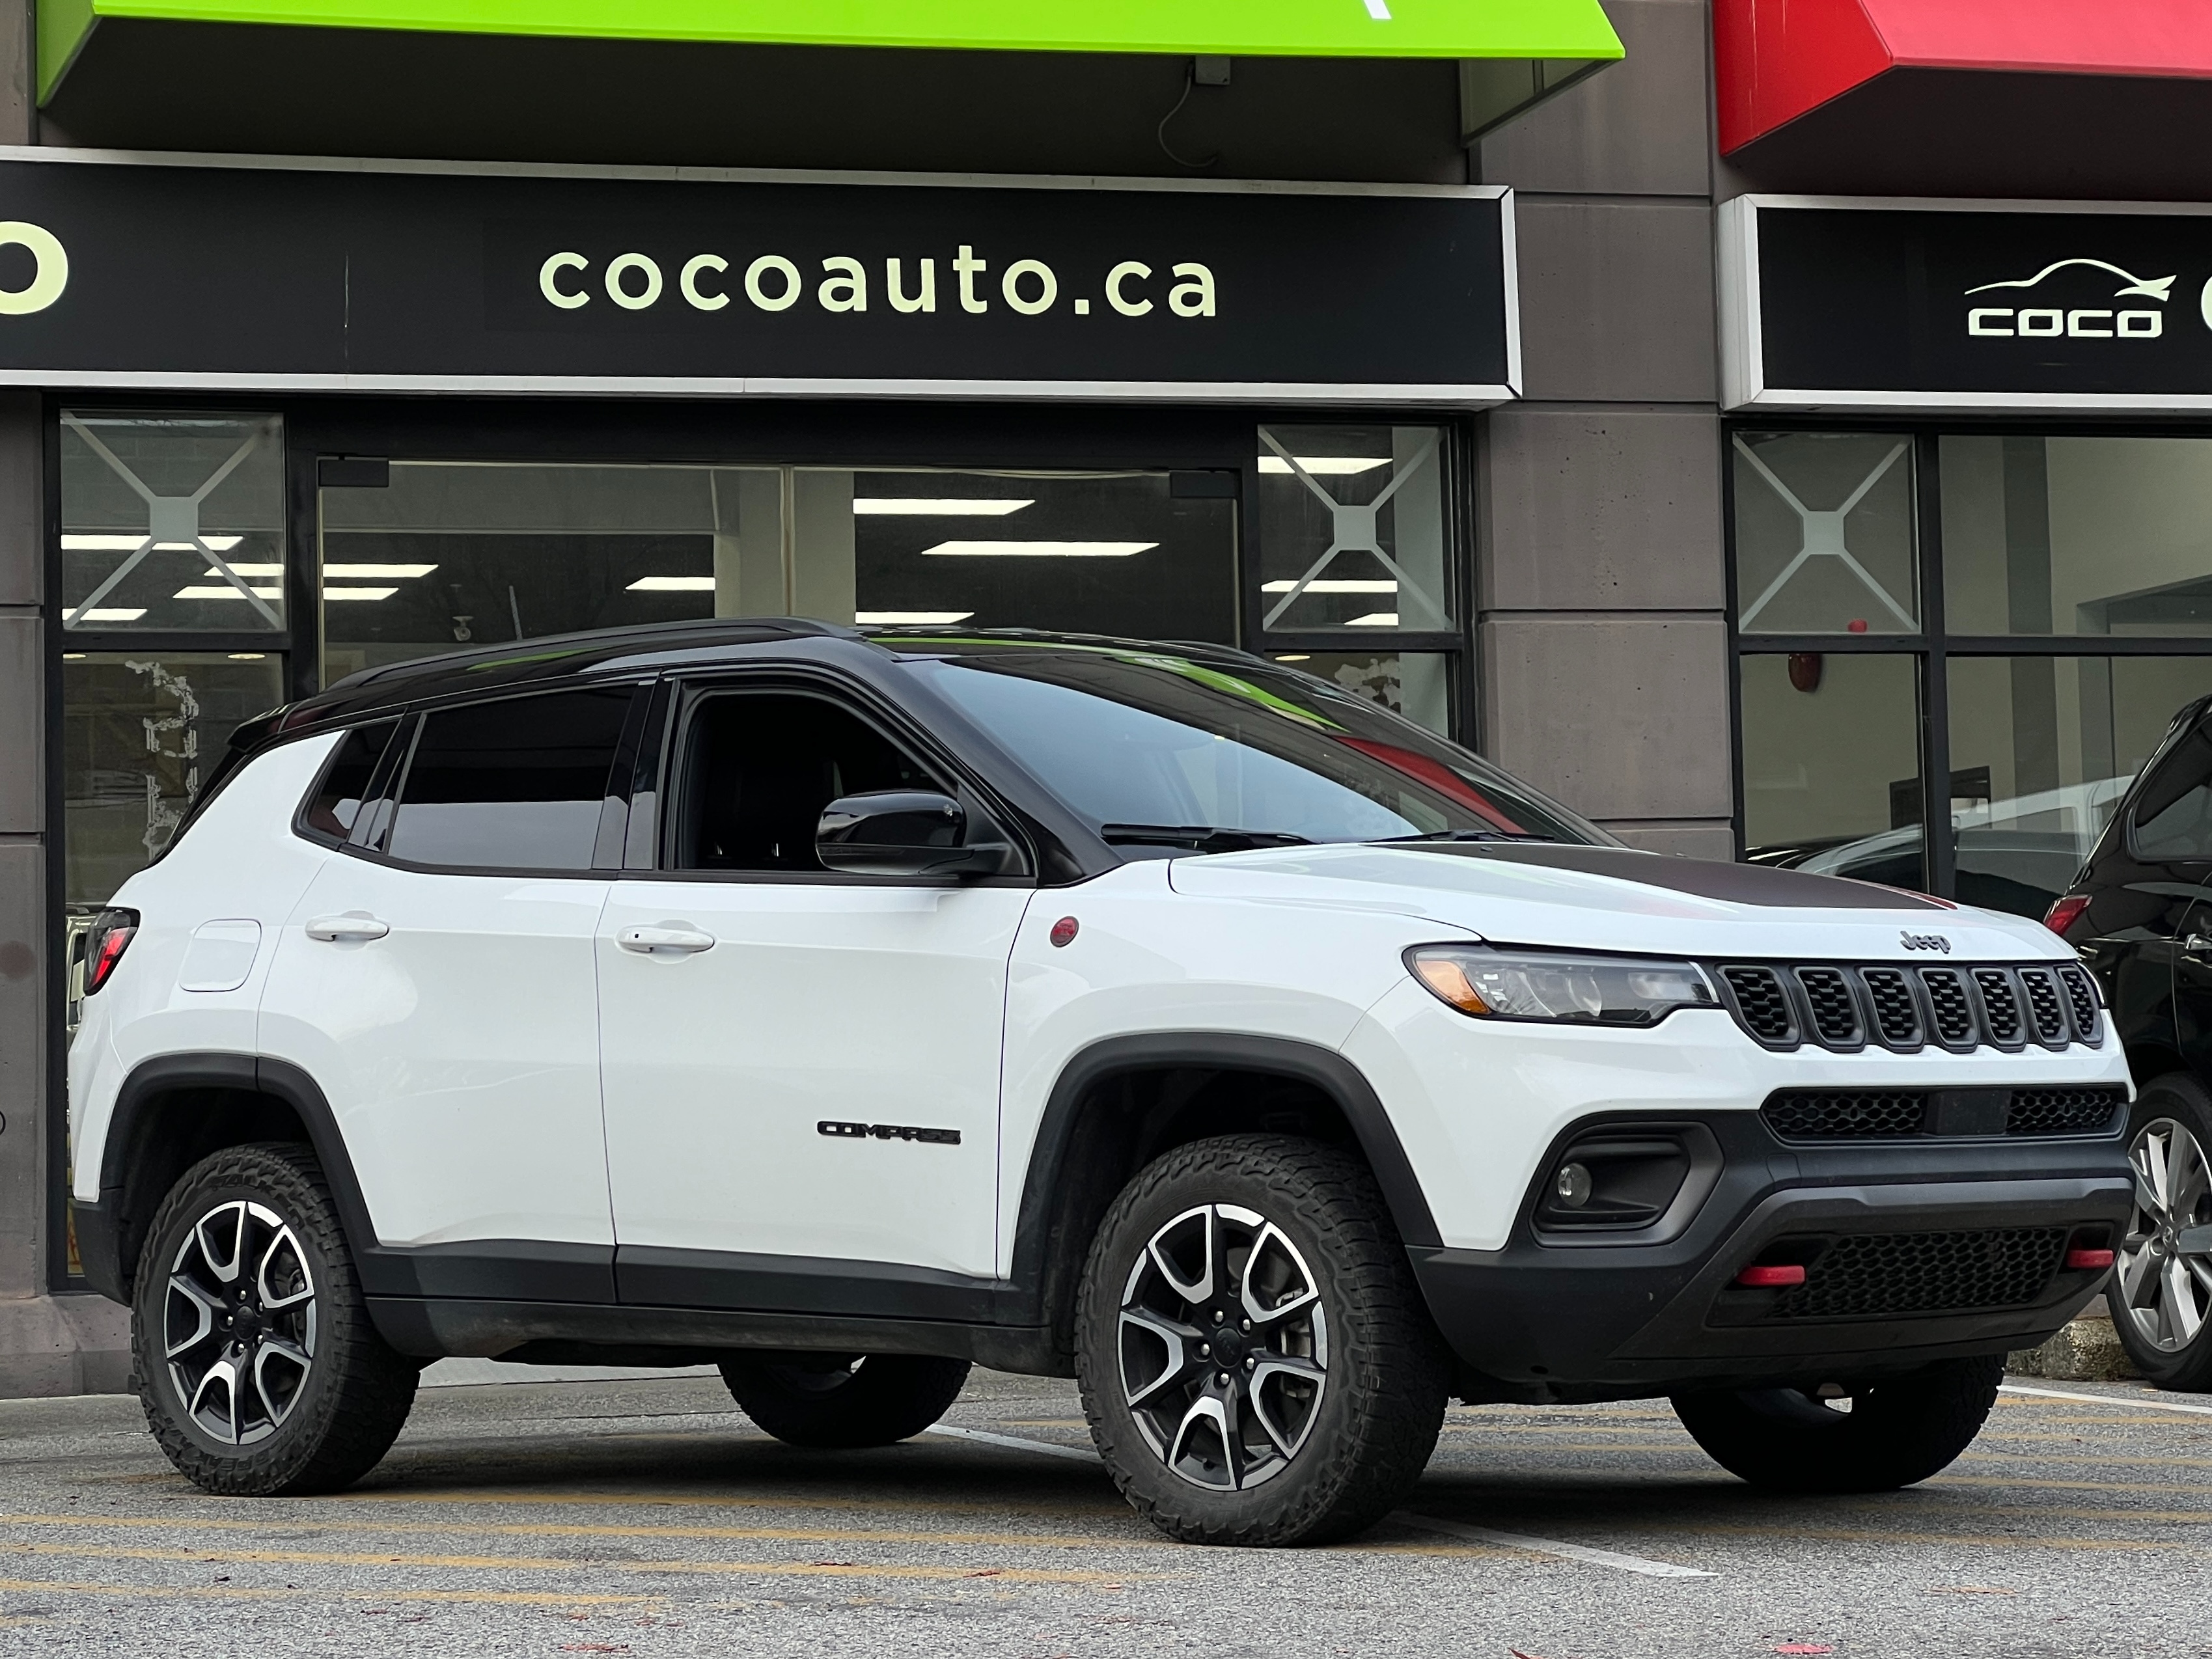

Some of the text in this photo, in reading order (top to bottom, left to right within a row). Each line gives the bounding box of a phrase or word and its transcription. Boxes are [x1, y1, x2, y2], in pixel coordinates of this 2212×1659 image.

[540, 245, 1216, 317] cocoauto.ca
[1968, 308, 2163, 338] COCO
[1900, 931, 1952, 954] Jeep
[817, 1121, 961, 1145] COMPASS
